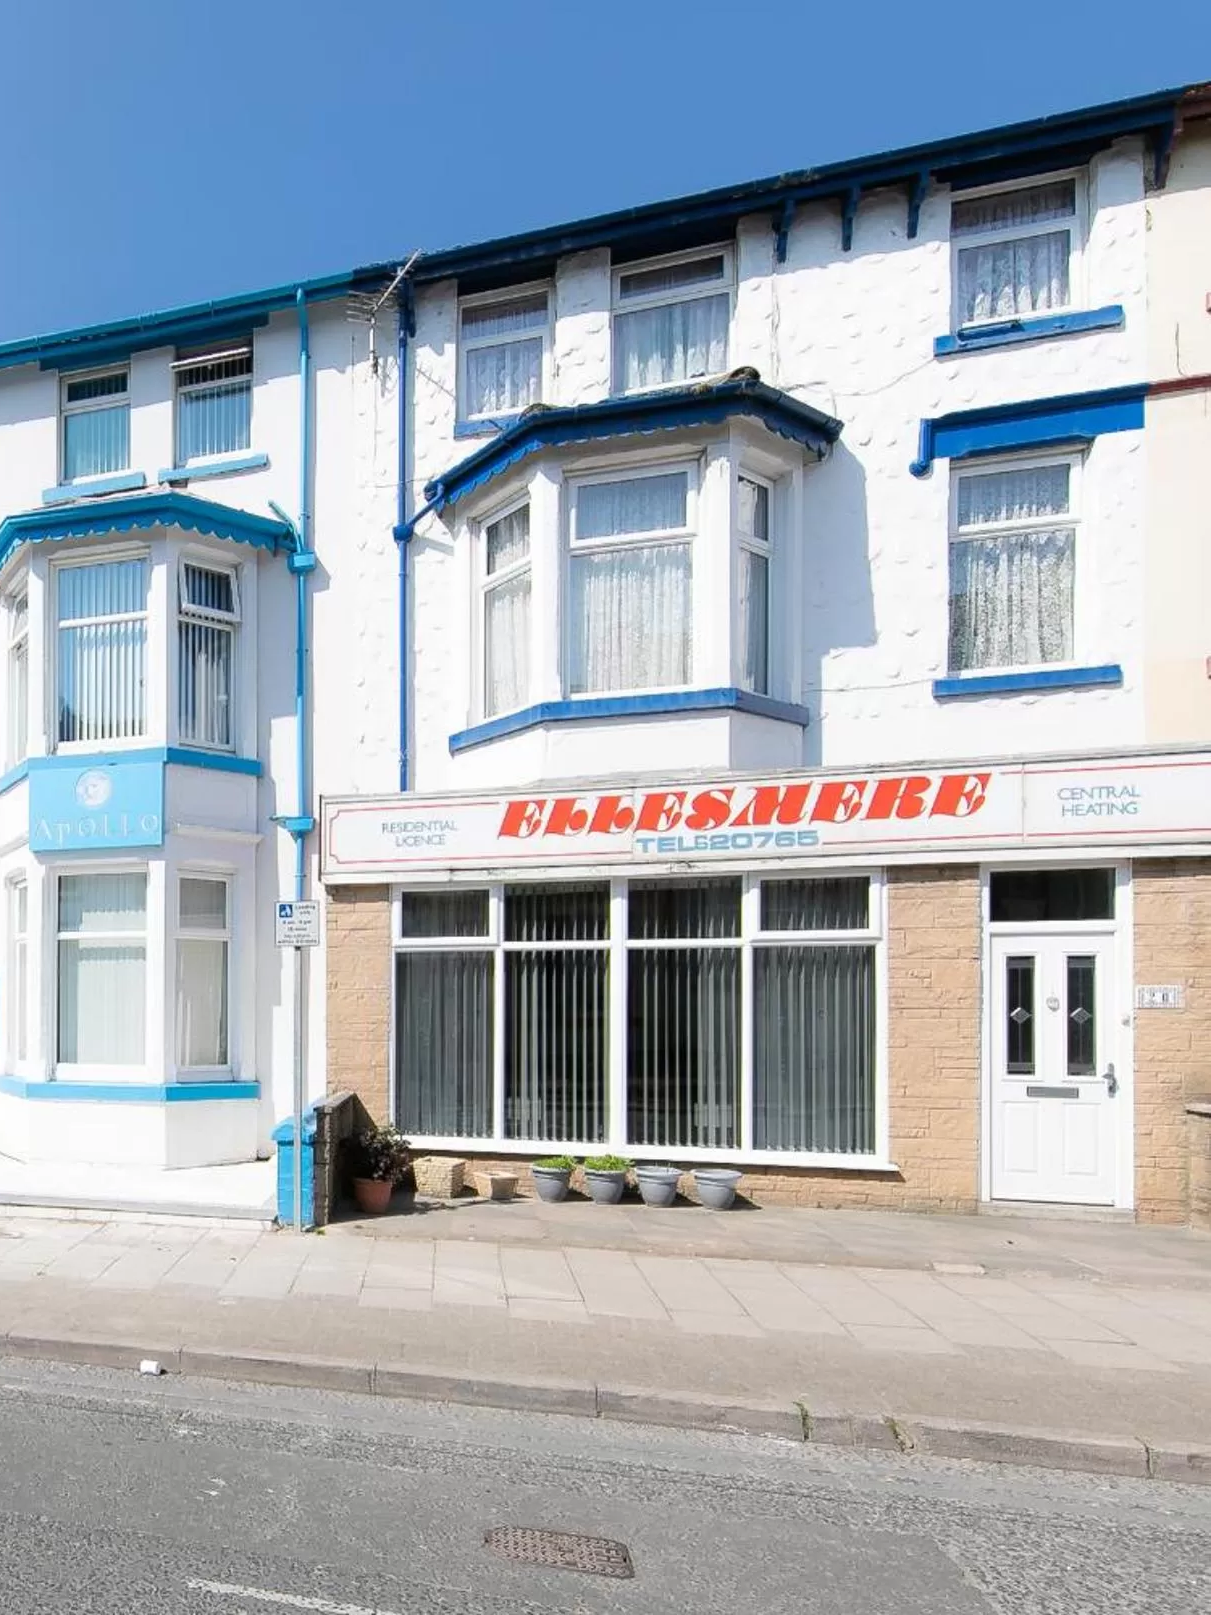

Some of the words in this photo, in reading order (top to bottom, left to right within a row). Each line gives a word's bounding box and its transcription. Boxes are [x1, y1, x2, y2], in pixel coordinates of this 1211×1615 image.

[1057, 785, 1141, 801] CENTRAL
[497, 772, 993, 840] ELLESMERE
[1061, 801, 1139, 817] HEATING
[381, 819, 459, 834] RESIDENTIAL
[395, 833, 446, 847] LICENCE
